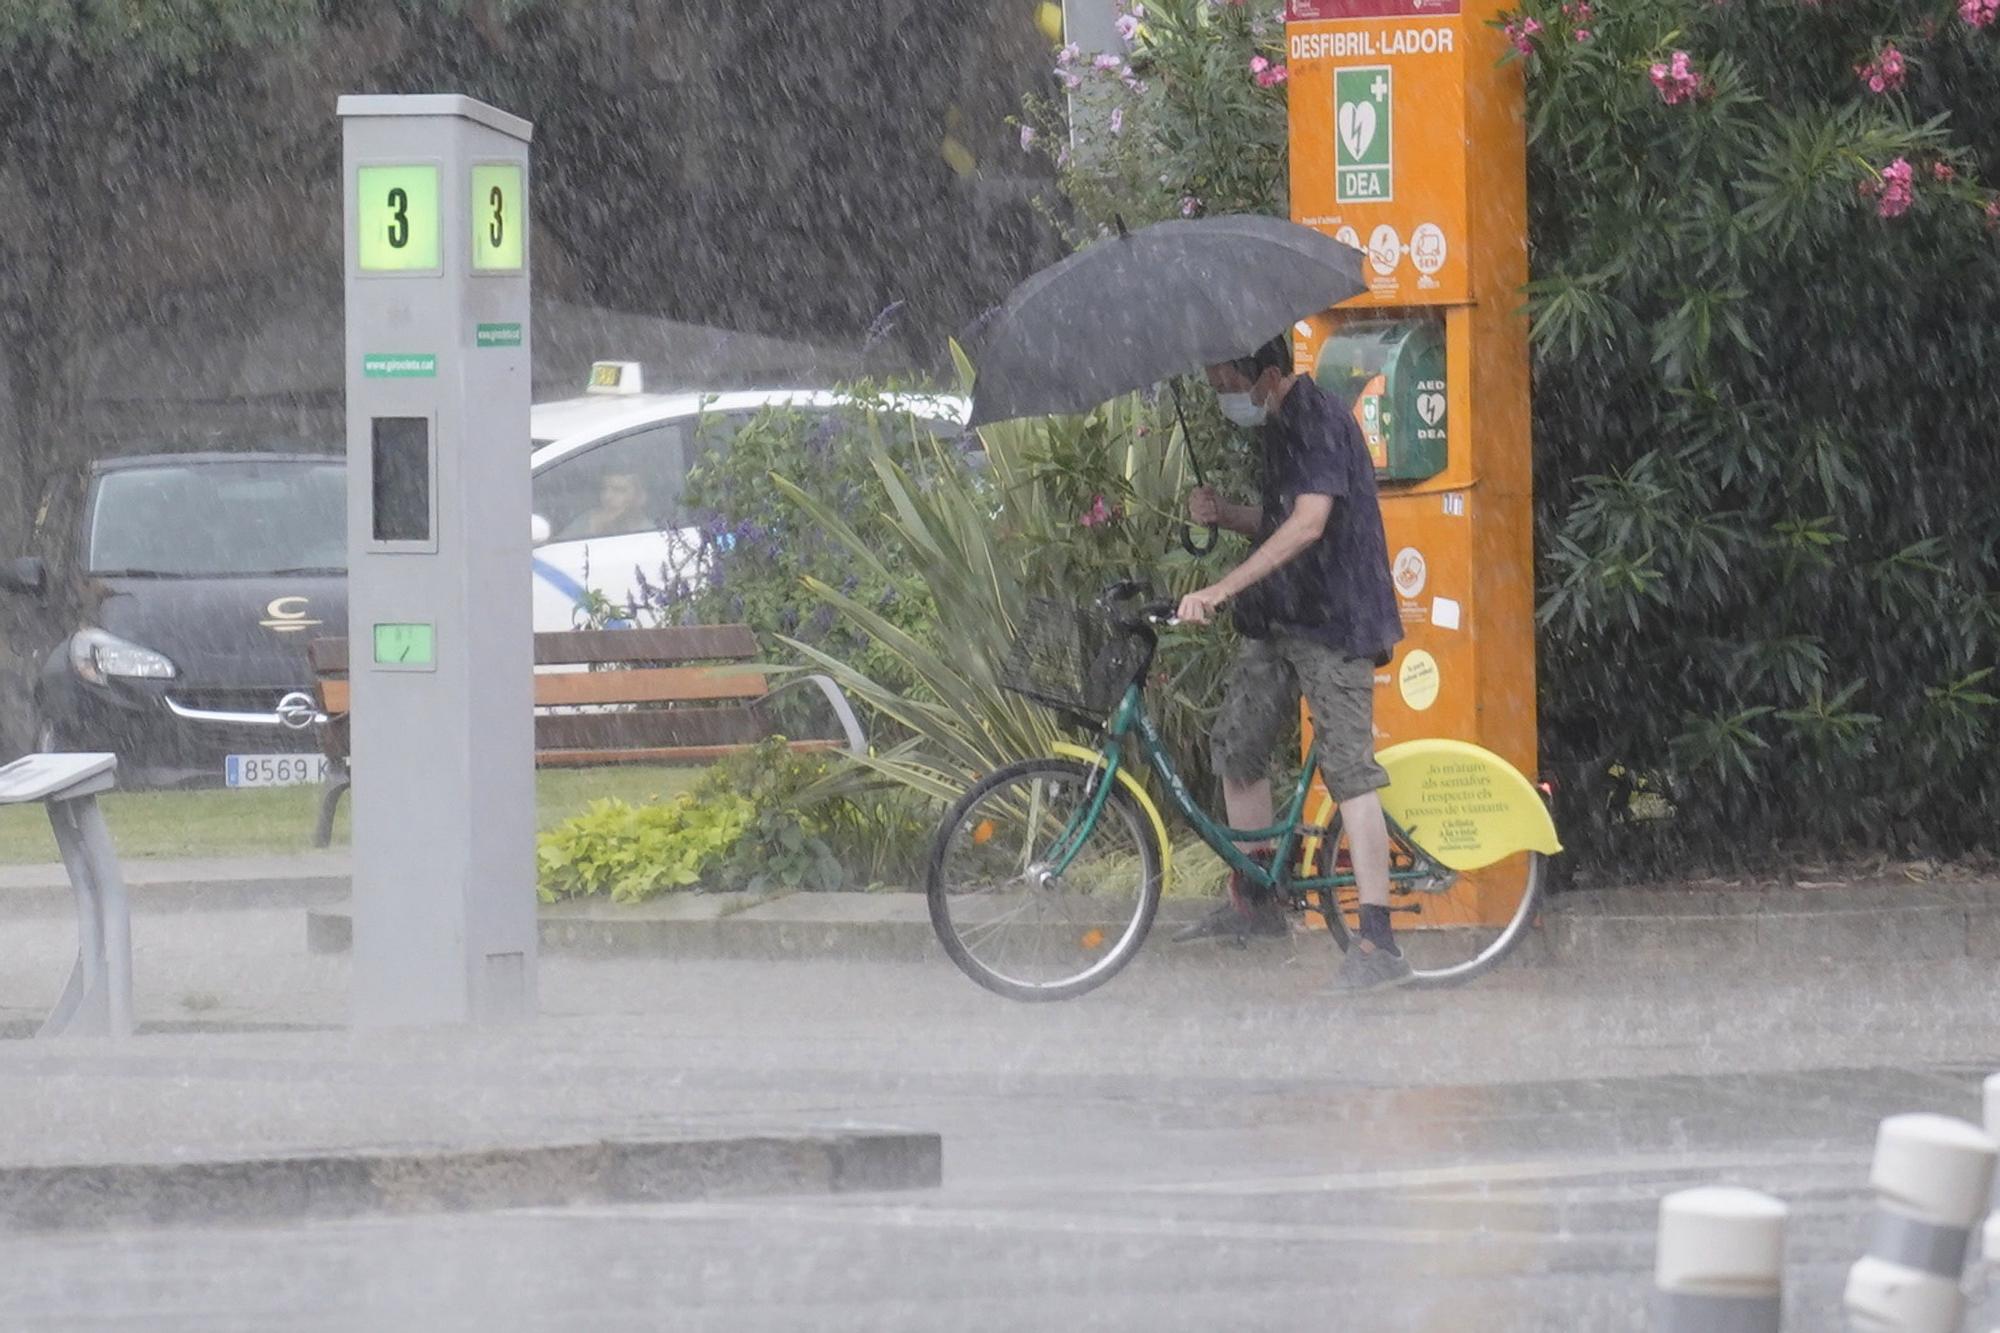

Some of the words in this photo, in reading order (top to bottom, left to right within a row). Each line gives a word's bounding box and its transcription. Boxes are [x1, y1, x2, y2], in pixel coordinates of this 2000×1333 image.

[1345, 171, 1381, 196] DEA
[387, 187, 409, 249] 3
[489, 185, 504, 249] 3
[1416, 380, 1445, 391] AED
[1416, 428, 1446, 439] DEA
[245, 759, 307, 782] 8569
